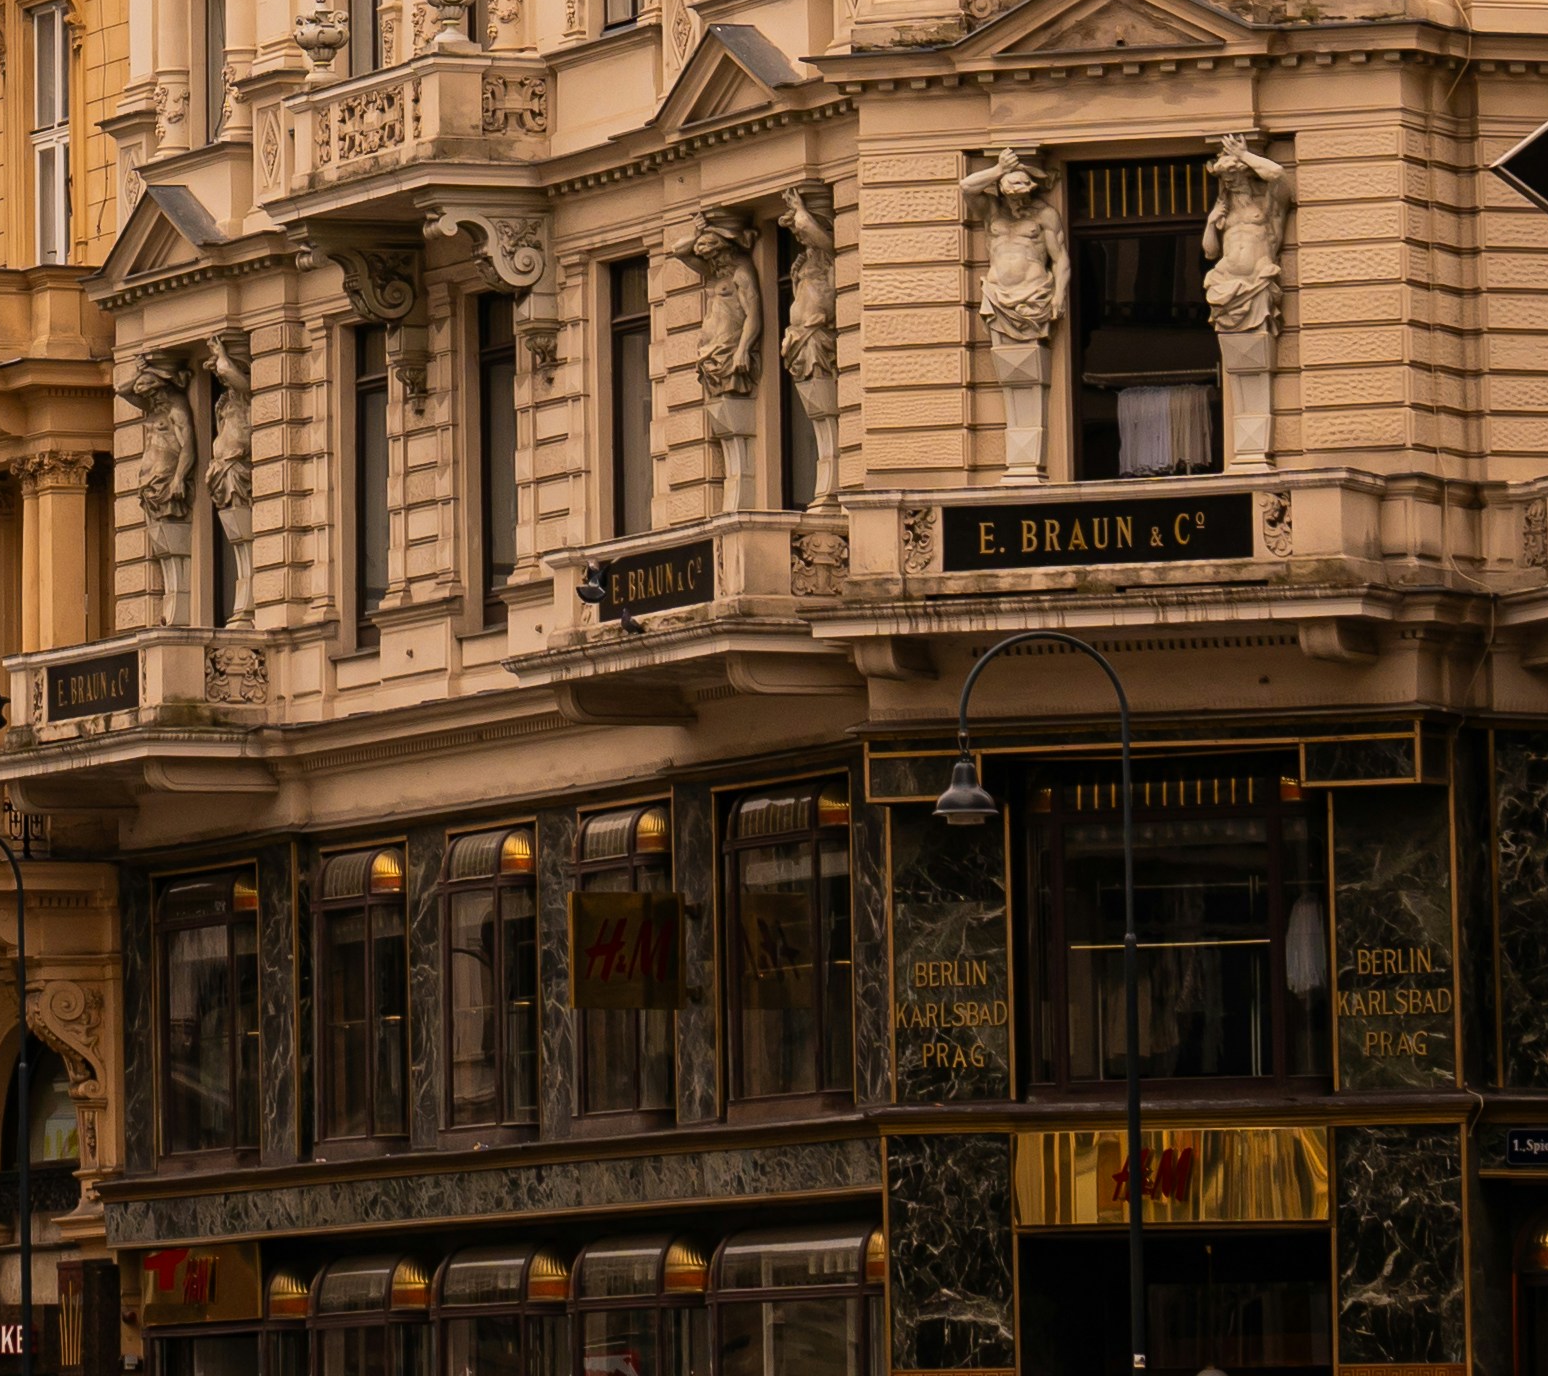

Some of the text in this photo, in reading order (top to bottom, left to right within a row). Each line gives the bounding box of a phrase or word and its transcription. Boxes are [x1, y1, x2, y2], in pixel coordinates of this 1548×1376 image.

[979, 521, 1006, 555] E.
[1021, 516, 1134, 553] BRAUN
[1150, 526, 1164, 547] &
[612, 574, 624, 604] E.
[628, 561, 673, 601] BRAUN
[677, 571, 684, 591] &
[57, 679, 68, 707] E.
[71, 671, 107, 705] BRAUN
[111, 679, 117, 697] &
[583, 917, 676, 984] H&M
[1357, 948, 1432, 975] BERLIN
[915, 960, 987, 987] BERLIN
[896, 1000, 1008, 1028] KARLSBAD
[1338, 988, 1452, 1016] KARLSBAD
[923, 1043, 985, 1068] PRAG
[1365, 1031, 1428, 1056] PRAG
